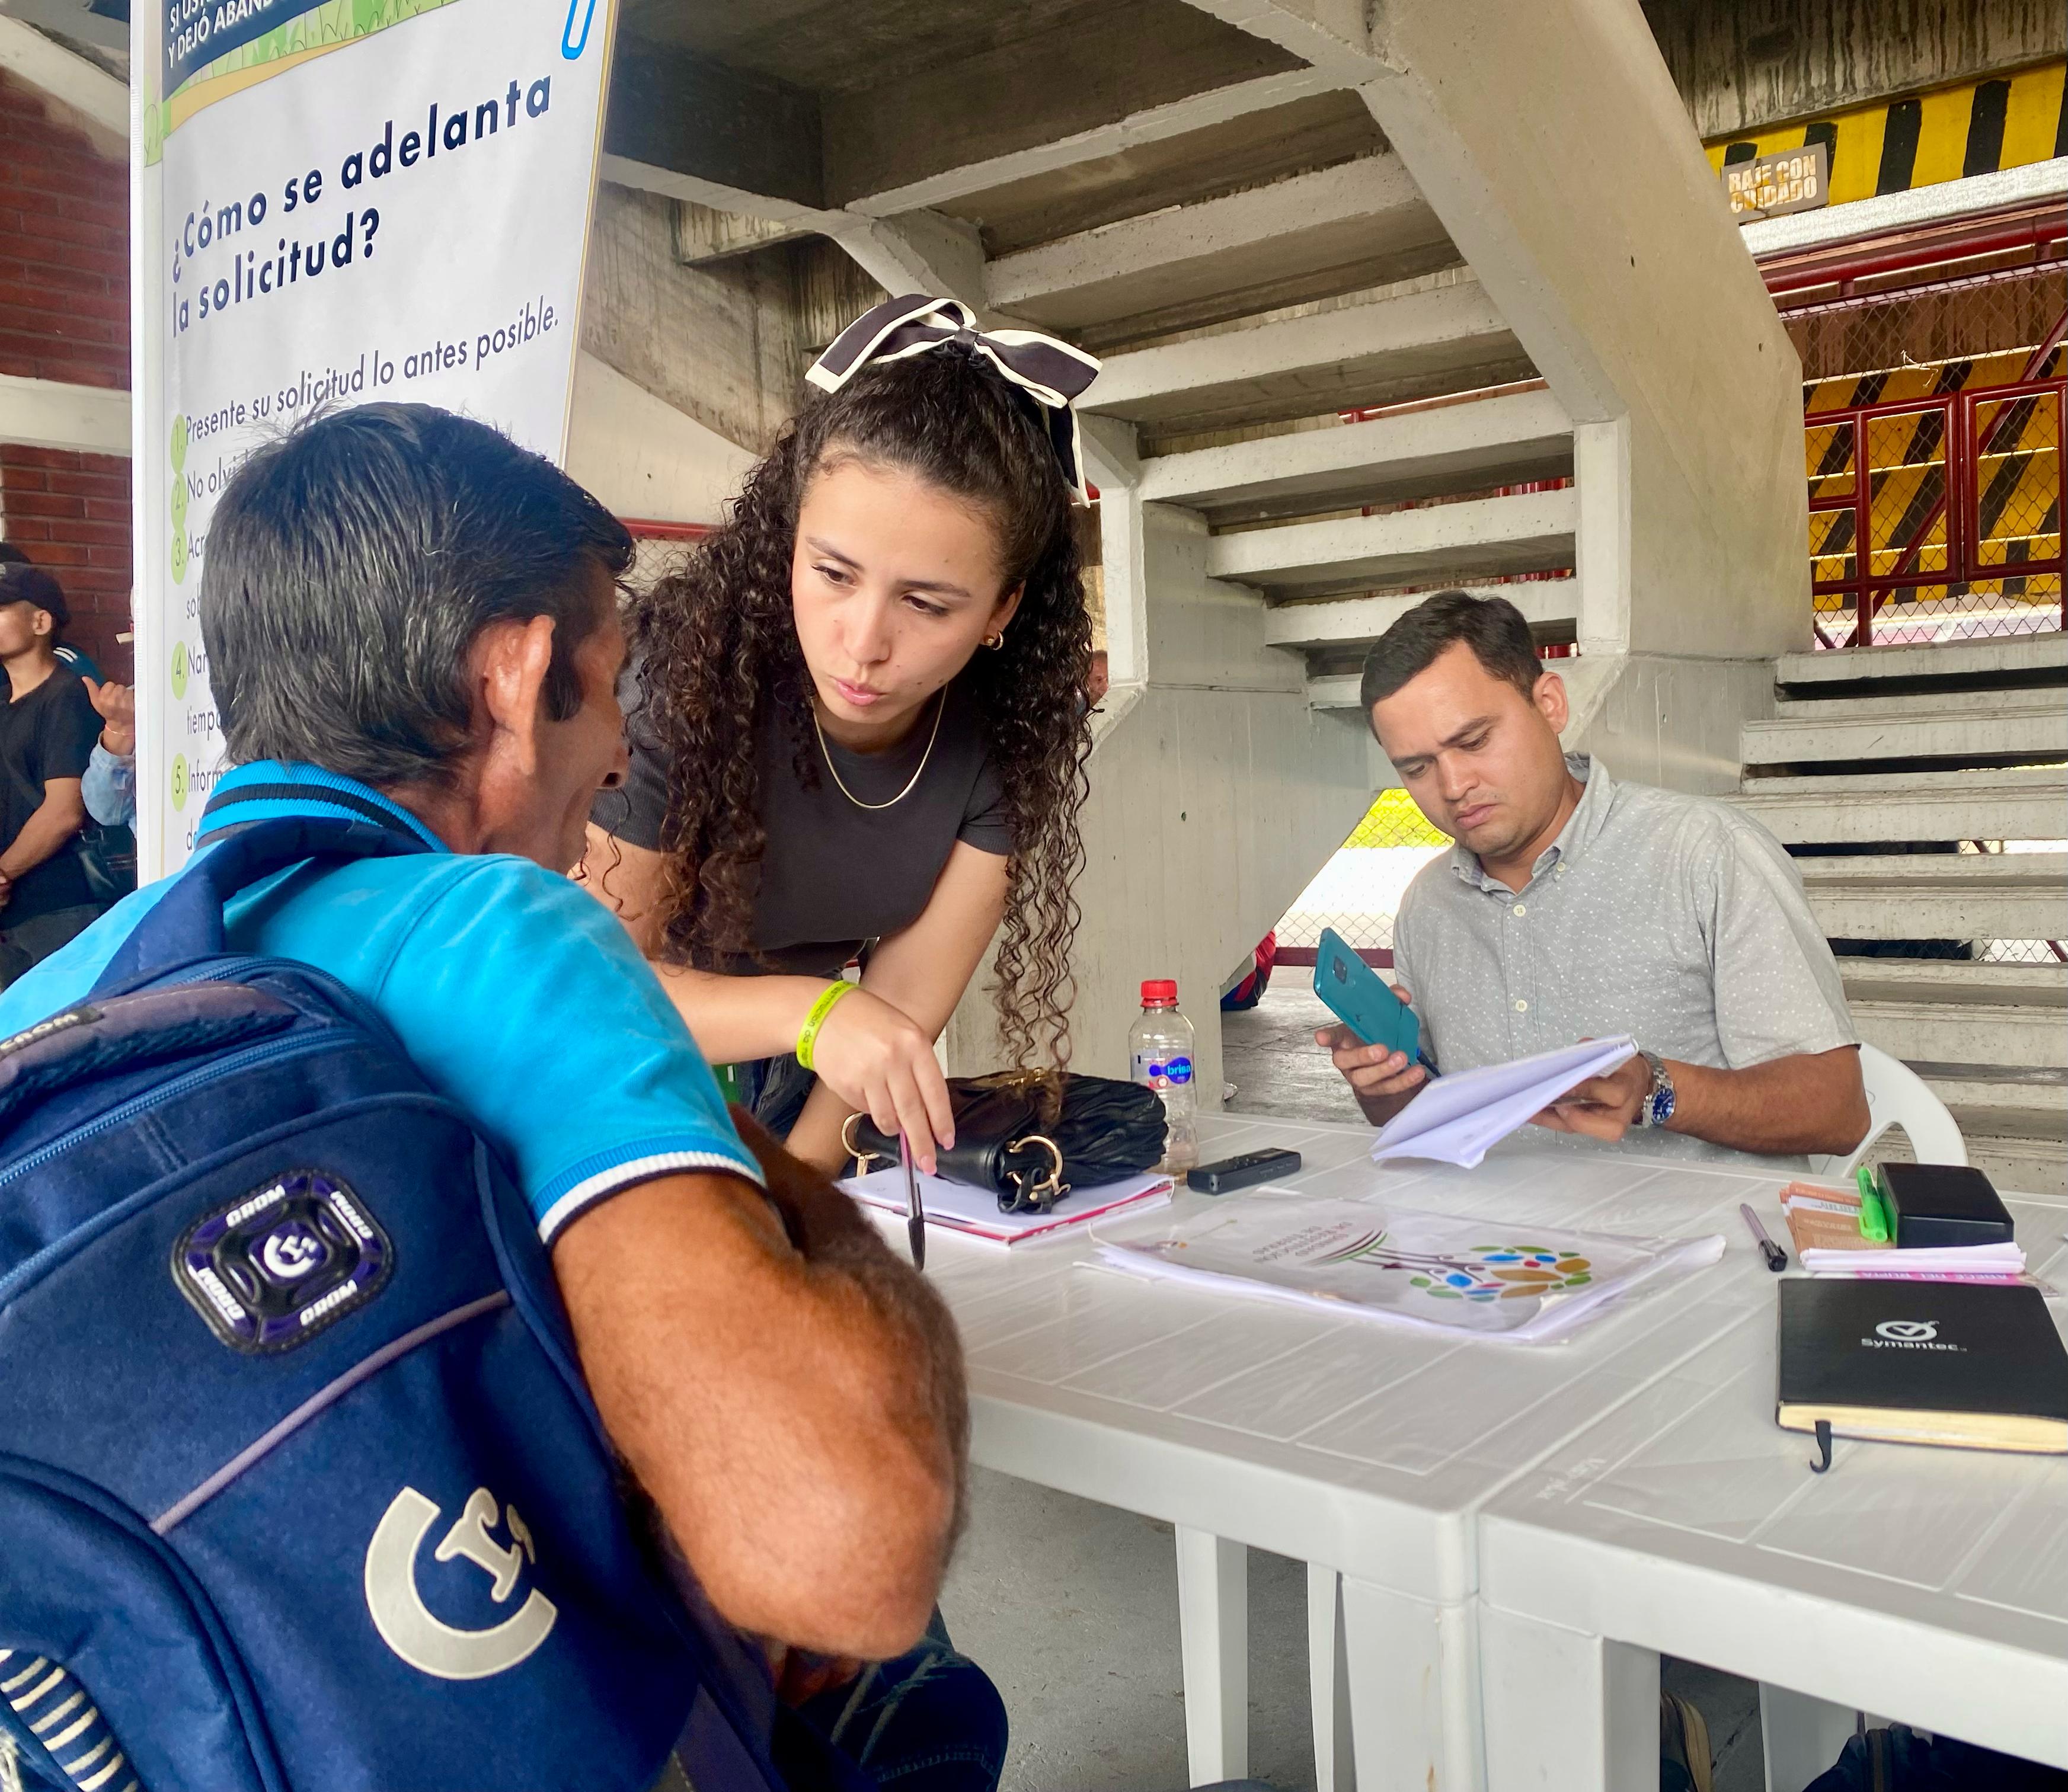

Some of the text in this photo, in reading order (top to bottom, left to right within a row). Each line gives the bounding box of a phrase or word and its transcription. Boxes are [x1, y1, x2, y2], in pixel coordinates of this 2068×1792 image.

[170, 3, 179, 33] SI
[168, 43, 175, 68] Y
[178, 8, 209, 61] DEJÓ
[171, 75, 552, 284] ¿Cómo se adelanta
[1776, 154, 1817, 183] CON
[1731, 176, 1817, 213] CUIDADO
[171, 207, 381, 338] la solicitud?
[186, 399, 246, 446] Presente
[252, 395, 270, 420] su
[277, 353, 364, 412] solicitud
[373, 350, 394, 387] lo
[404, 340, 468, 379] antes
[476, 294, 559, 371] posible.
[187, 471, 203, 503] No
[175, 652, 184, 680] 4.
[175, 764, 184, 794] 5.
[1861, 1337, 1958, 1351] Symantec
